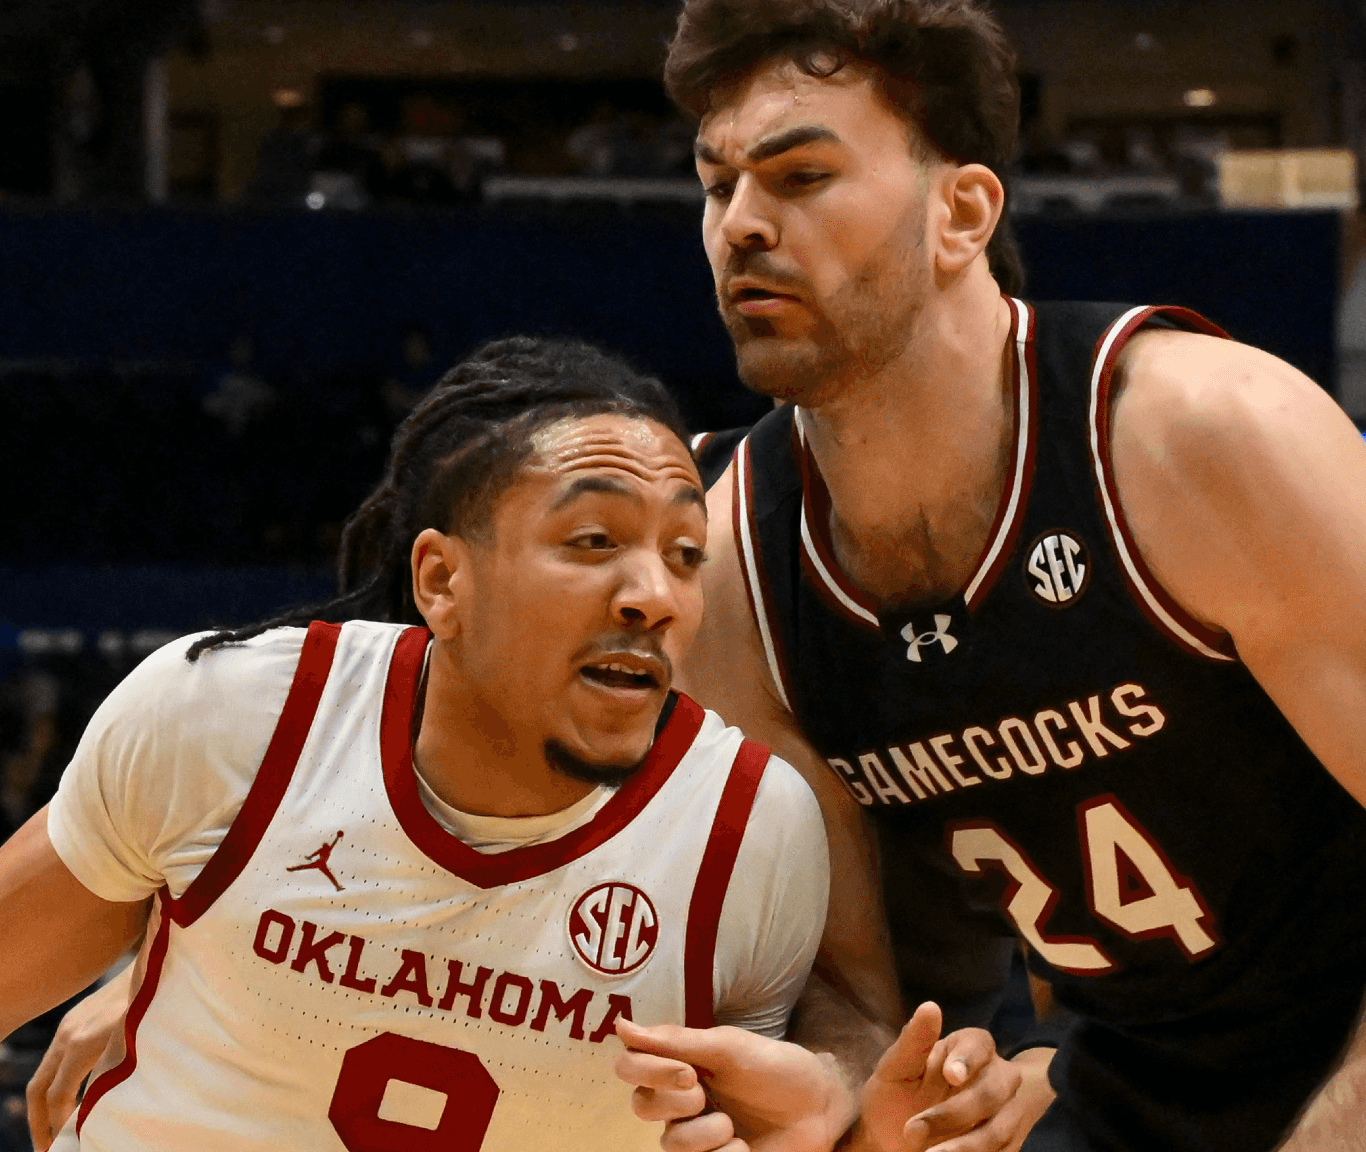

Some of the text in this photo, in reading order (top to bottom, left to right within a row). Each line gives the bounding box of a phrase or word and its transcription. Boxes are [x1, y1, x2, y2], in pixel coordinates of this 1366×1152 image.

[1027, 533, 1087, 603] SEC
[825, 682, 1167, 807] GAMECOCKS
[574, 886, 655, 971] SEC
[949, 800, 1218, 972] 24
[252, 908, 634, 1044] OKLAHOMA
